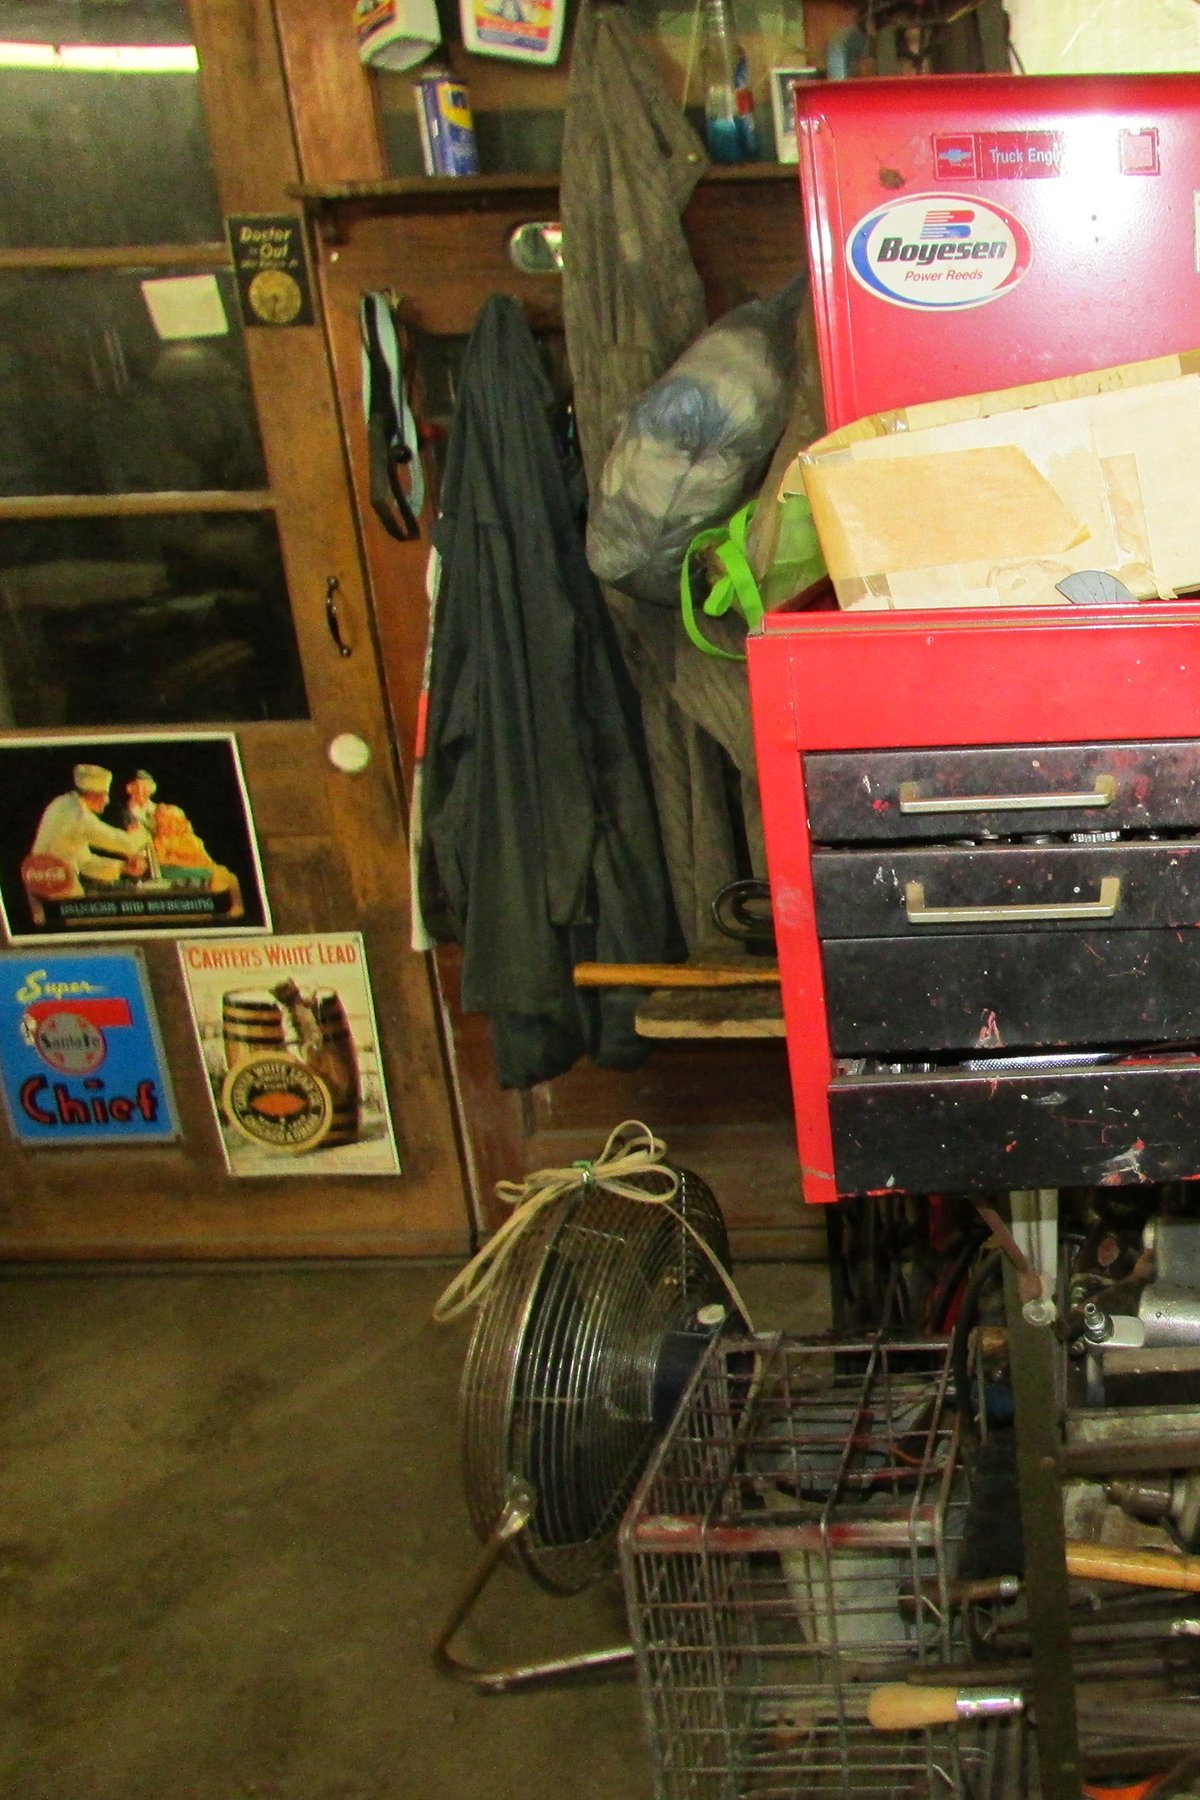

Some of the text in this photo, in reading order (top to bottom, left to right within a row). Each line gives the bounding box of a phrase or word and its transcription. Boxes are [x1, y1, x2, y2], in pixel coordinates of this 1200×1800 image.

[989, 147, 1023, 164] Truck
[877, 237, 1008, 266] Boyesen
[904, 269, 984, 282] Power Reeds
[264, 943, 313, 966] WHITE
[317, 942, 357, 965] LEAD
[16, 969, 102, 1004] Super
[20, 1073, 158, 1125] Chief
